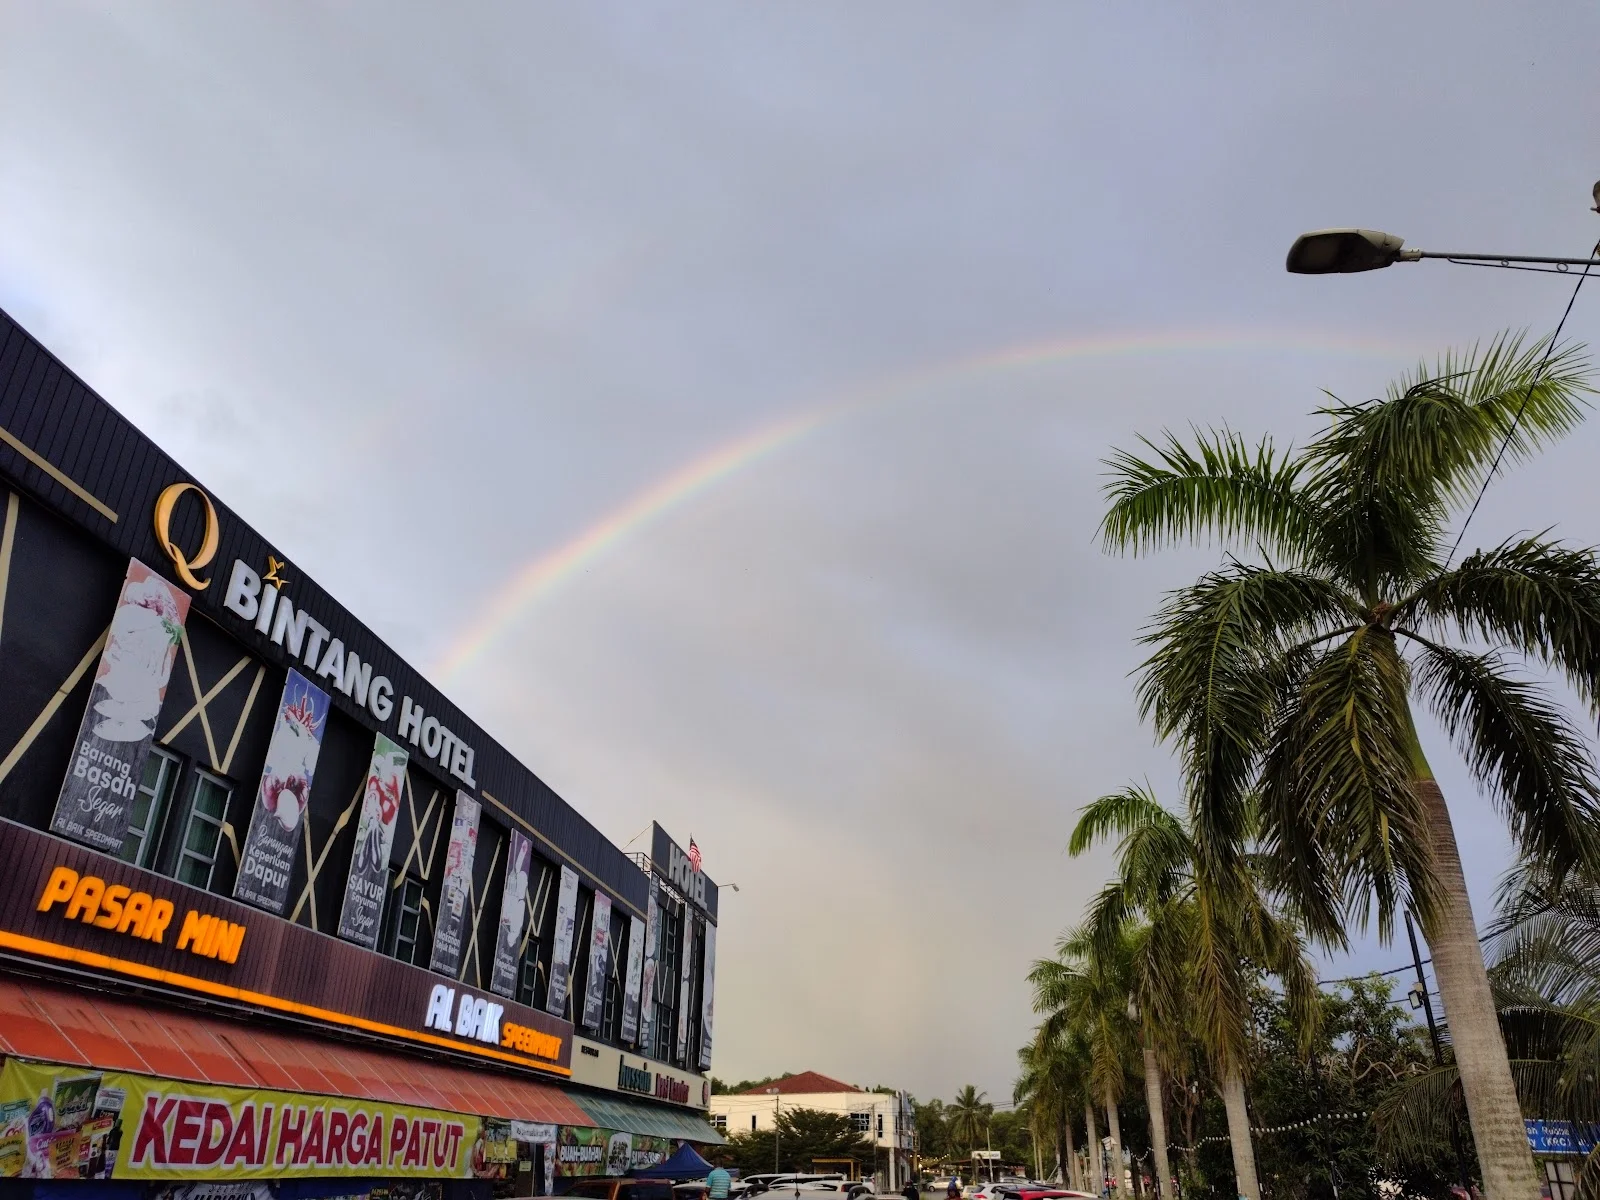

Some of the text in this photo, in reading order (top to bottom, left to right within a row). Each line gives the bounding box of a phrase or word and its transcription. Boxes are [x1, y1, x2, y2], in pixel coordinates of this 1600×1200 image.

[155, 482, 476, 790] Q BINTANG HOTEL
[73, 756, 137, 800] Basah
[80, 741, 131, 779] Barang
[78, 786, 124, 822] Segar
[55, 818, 123, 849] AL BAIK SPEEDMART
[244, 856, 288, 889] Dapur
[249, 844, 291, 872] Keperluan
[669, 842, 708, 911] HOTEL
[349, 874, 383, 902] SAYUR
[37, 866, 247, 965] PASAR MINI
[424, 984, 563, 1060] AL BAIK SPEEDMART
[618, 1054, 652, 1093] hussain
[132, 1096, 463, 1168] KEDAI HARGA PATUT
